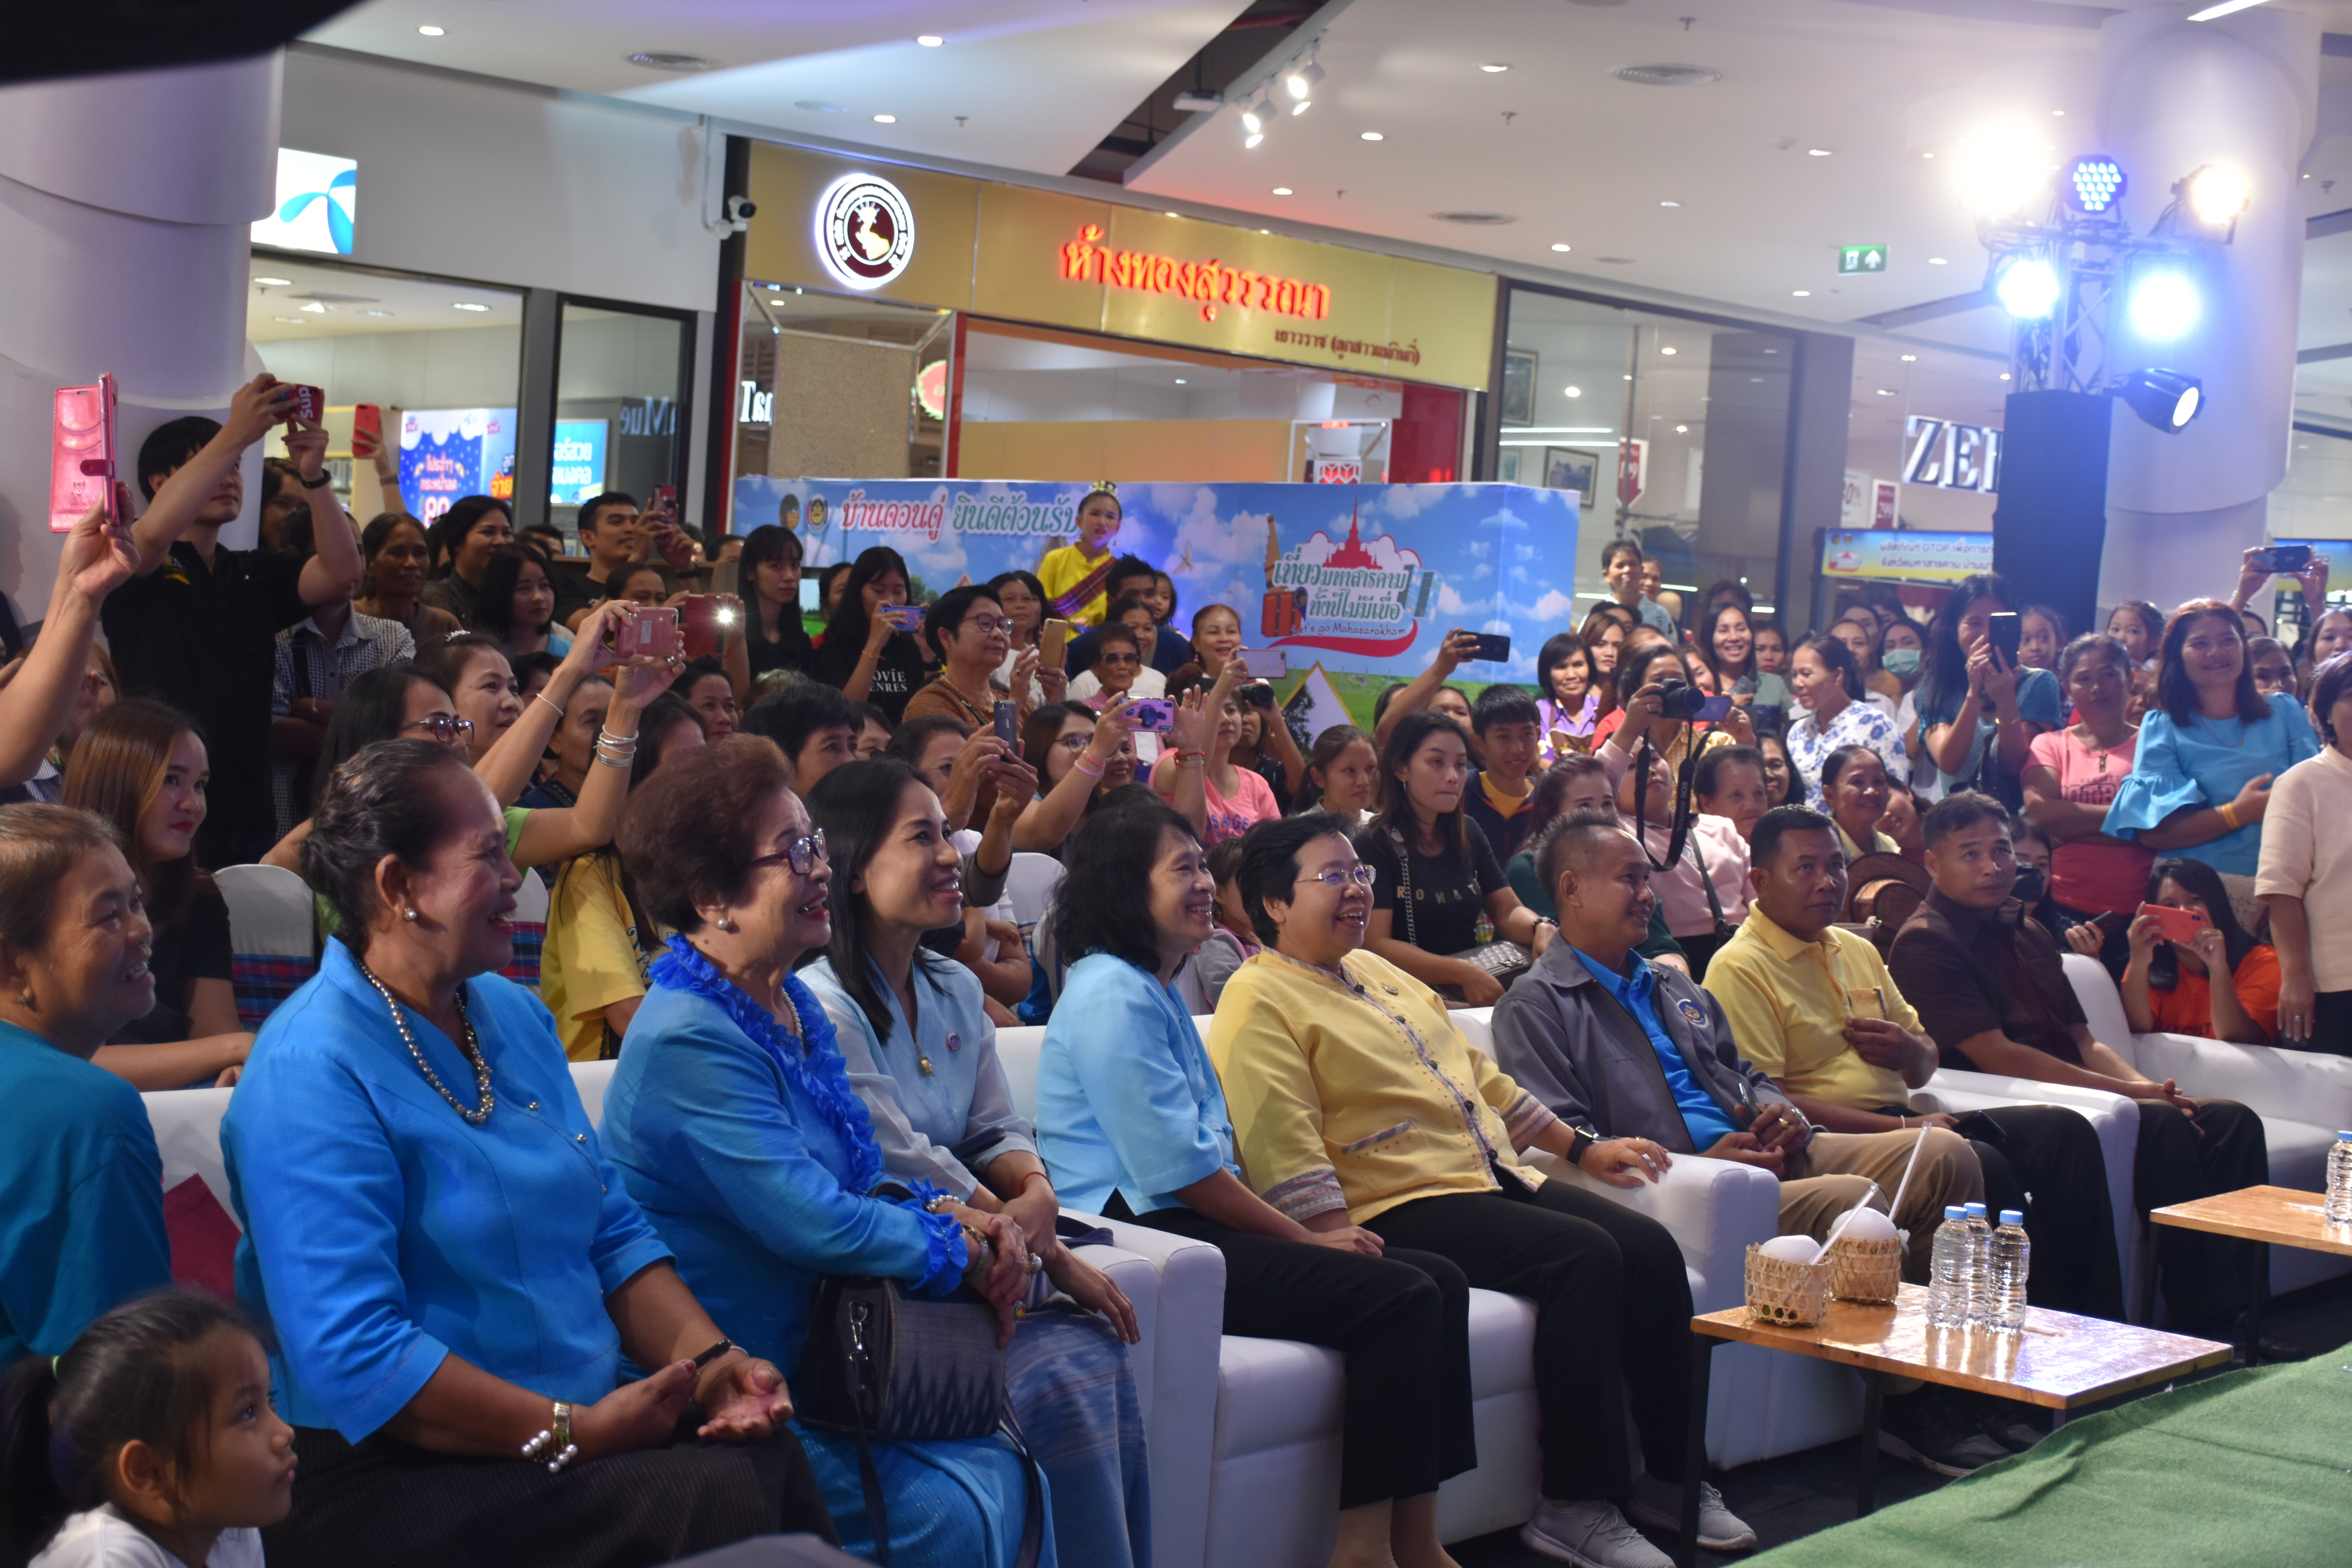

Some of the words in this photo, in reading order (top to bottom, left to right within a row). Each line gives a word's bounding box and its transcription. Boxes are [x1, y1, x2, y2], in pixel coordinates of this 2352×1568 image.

[1061, 224, 1330, 322] ห้างทองสุวรรณา
[842, 491, 947, 539] บ้านดอนดู่
[953, 493, 1079, 533] ยินดีต้อนรับ
[1318, 626, 1330, 635] go
[1332, 623, 1406, 635] Mahasarakham
[869, 682, 907, 692] ENRES
